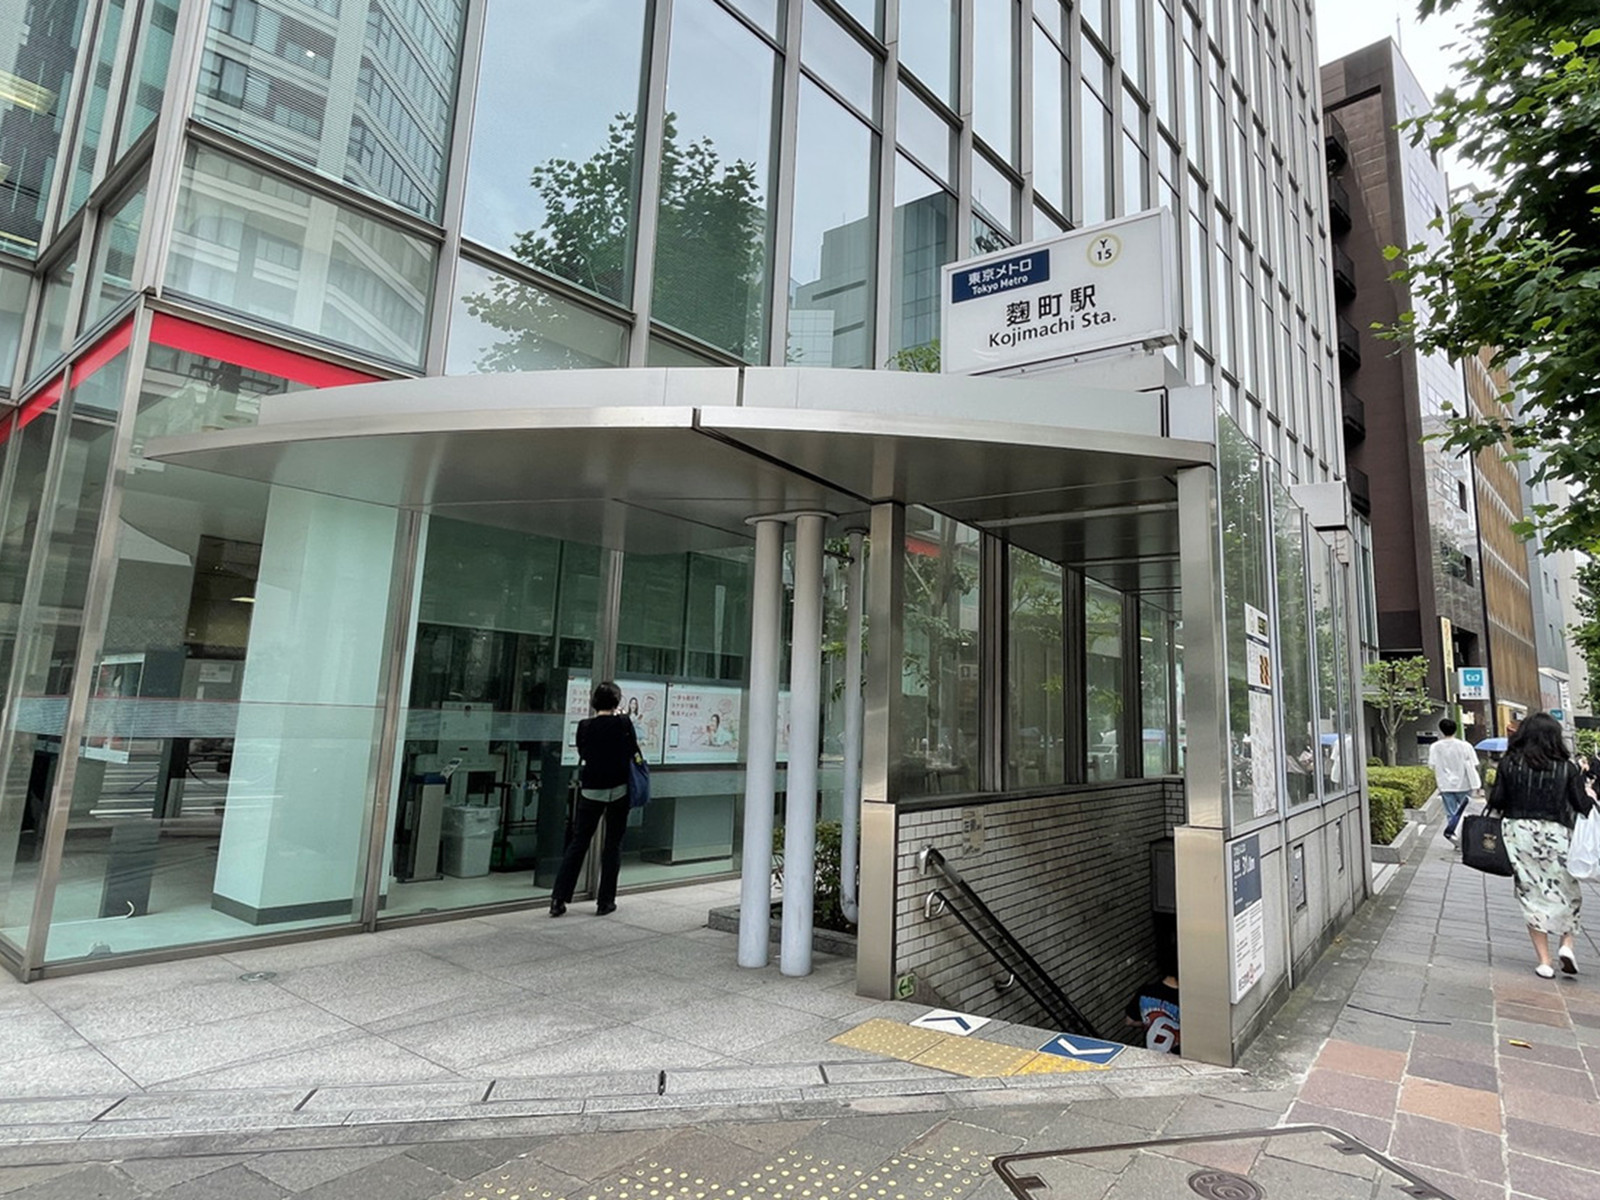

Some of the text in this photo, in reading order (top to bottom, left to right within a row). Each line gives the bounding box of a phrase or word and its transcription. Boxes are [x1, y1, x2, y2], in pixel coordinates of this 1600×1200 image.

[1099, 238, 1109, 249] Y
[1096, 249, 1113, 262] 15
[967, 258, 1032, 286] 東京メトロ
[971, 274, 1028, 296] Tokyo Metro
[988, 311, 1117, 348] Kojimachi Sta.
